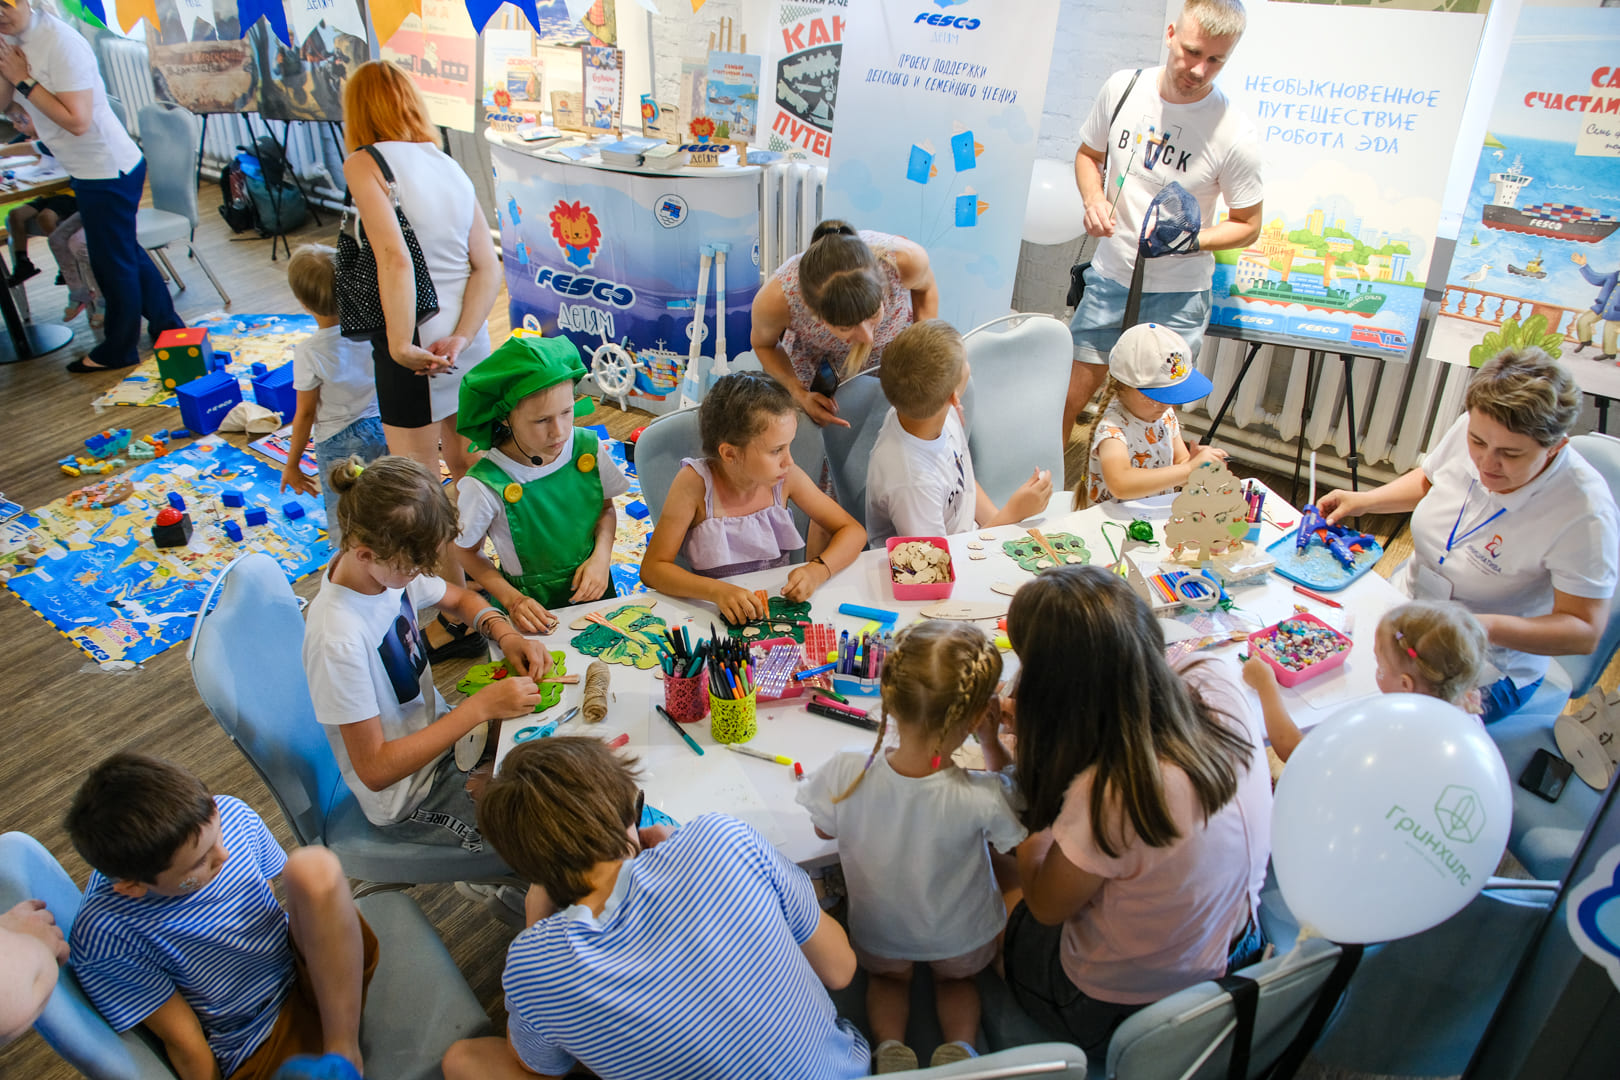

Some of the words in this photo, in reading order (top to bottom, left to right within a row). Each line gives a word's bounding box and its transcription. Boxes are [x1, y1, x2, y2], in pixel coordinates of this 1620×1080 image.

[914, 12, 981, 31] FESCO
[898, 53, 930, 71] ПРОЕКТ
[932, 58, 988, 79] ПОДДЕРЖКИ
[865, 68, 910, 88] ДЕТСКОГО
[913, 75, 920, 88] И
[924, 77, 977, 98] СЕМЕЙНОГО
[982, 86, 1018, 105] ЧТЕНИЯ
[1245, 75, 1441, 108] НЕОБЫКНОВЕННОЕ
[1257, 100, 1419, 132] ПУТЕШЕСТВИЕ
[677, 144, 730, 153] FESCO
[1265, 125, 1345, 150] РОБОТА
[1355, 134, 1400, 155] ЭДА
[1528, 218, 1563, 231] FESCO
[537, 269, 634, 306] FESCO
[558, 302, 616, 338] ДЕТЯМ
[1232, 314, 1274, 326] FESCO
[1297, 323, 1340, 334] FESCO
[74, 635, 111, 661] FESCO
